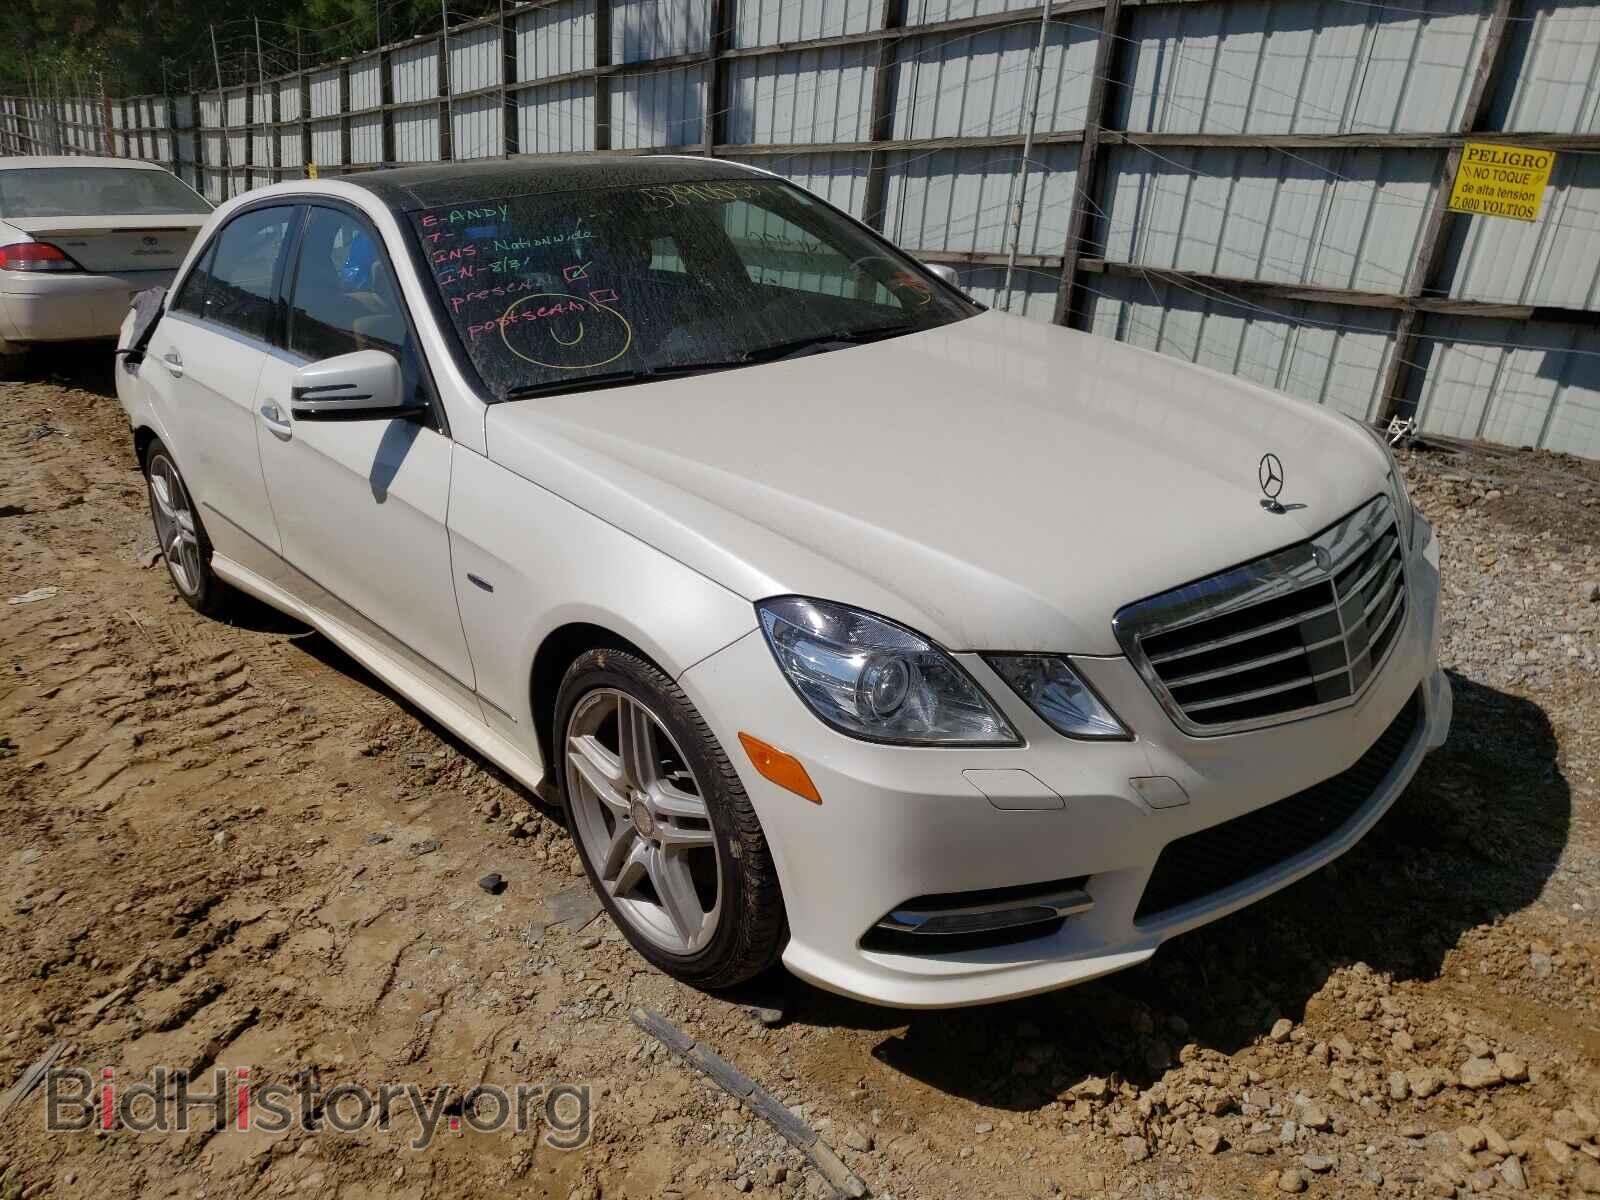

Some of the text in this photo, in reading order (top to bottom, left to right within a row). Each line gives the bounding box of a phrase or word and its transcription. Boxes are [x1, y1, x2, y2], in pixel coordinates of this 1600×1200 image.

[1467, 148, 1548, 169] PELIGRO
[1473, 168, 1531, 186] NO TOQUE
[1462, 182, 1474, 193] de
[1478, 184, 1495, 196] alta
[1483, 200, 1535, 218] VOLTIOS
